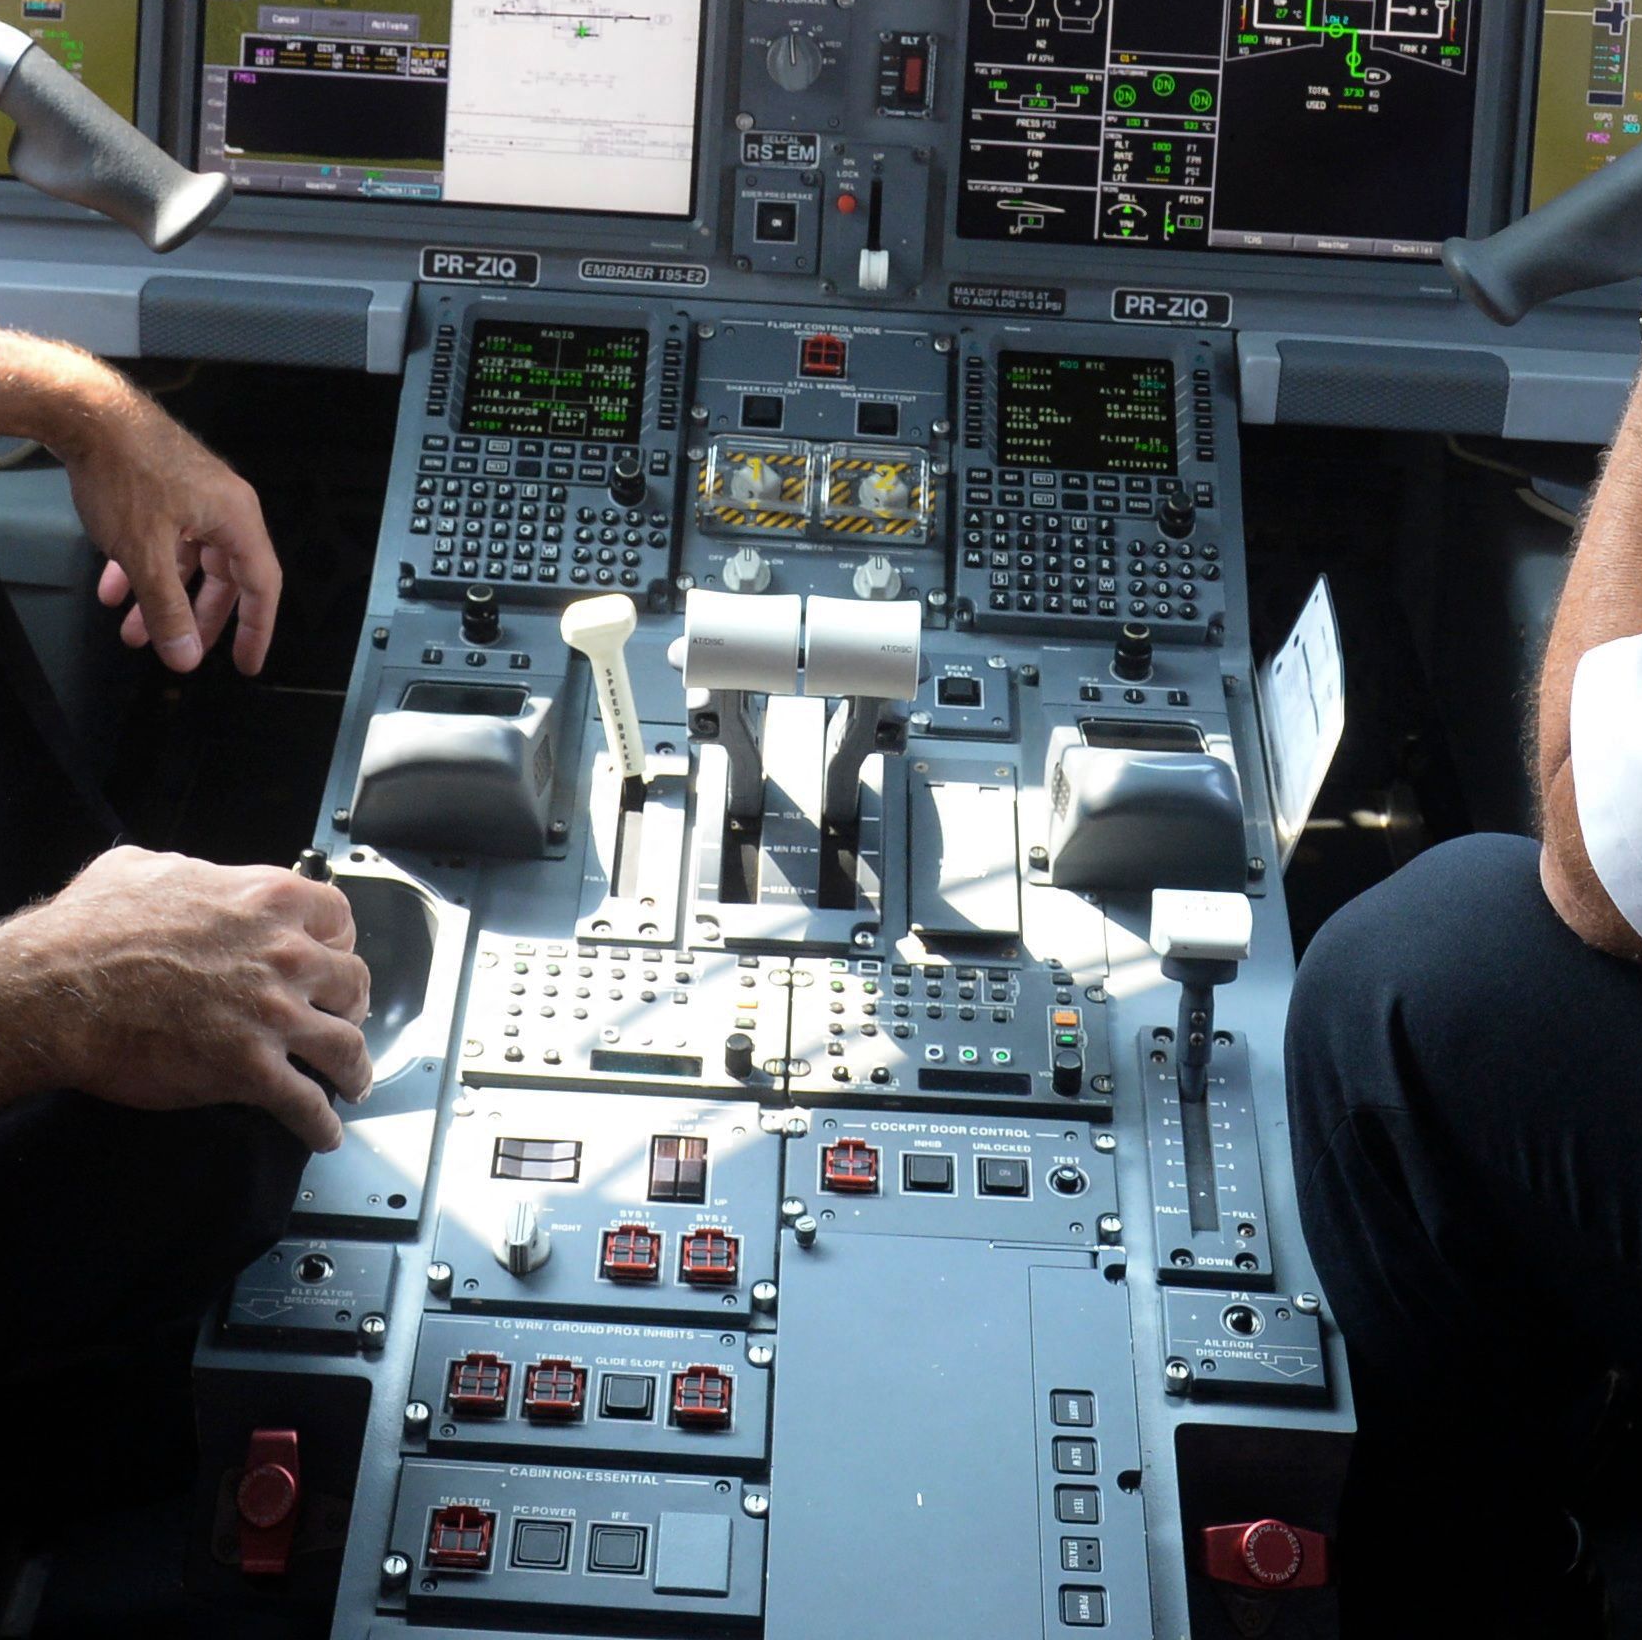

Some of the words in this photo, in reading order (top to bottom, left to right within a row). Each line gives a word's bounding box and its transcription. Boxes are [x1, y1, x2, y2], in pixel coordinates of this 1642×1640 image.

[901, 36, 919, 45] ELT
[1158, 79, 1171, 90] DN
[1117, 90, 1133, 102] DN
[1193, 95, 1208, 106] DN
[763, 136, 800, 144] SELCAL
[747, 144, 814, 160] RS-EM
[433, 254, 516, 278] PR-ZIQ
[583, 263, 654, 280] EMBRAER
[659, 269, 704, 283] 195-E2
[954, 287, 975, 297] MAX
[977, 288, 998, 298] DIFF
[1002, 289, 1033, 300] PRESS
[1035, 291, 1050, 300] AT
[970, 297, 992, 307] AND
[995, 298, 1016, 308] LDG
[1045, 302, 1062, 311] PSI
[1125, 295, 1209, 319] PR-ZIQ
[767, 322, 802, 330] FLIGHT
[806, 323, 851, 333] CONTROL
[541, 330, 575, 340] RADIO
[726, 384, 758, 392] SHAKER
[767, 387, 801, 395] CUTOUT
[787, 381, 813, 389] STALL
[817, 383, 856, 391] WARNING
[840, 391, 873, 399] SHAKER
[882, 394, 917, 402] CUTOUT
[592, 428, 625, 437] IDENT
[875, 465, 896, 492] 2
[692, 637, 724, 646] AT/DISC
[880, 644, 912, 654] AT/DISC
[604, 668, 621, 721] SPEED
[617, 723, 633, 771] BRAKE
[773, 845, 788, 854] MIN
[790, 845, 808, 854] REV
[871, 1122, 928, 1133] COCKPIT
[930, 1124, 967, 1135] DOOR
[970, 1127, 1031, 1138] CONTROL
[914, 1140, 942, 1148] INHIB
[972, 1142, 1031, 1153] UNLOCKED
[1053, 1156, 1080, 1164] TEST
[619, 1210, 643, 1219] SYS
[696, 1214, 719, 1223] SYS
[1155, 1207, 1179, 1215] FULL
[1232, 1211, 1257, 1220] FULL
[551, 1223, 582, 1232] RIGHT
[310, 1242, 327, 1250] PA
[1198, 1257, 1233, 1267] DOWN
[291, 1288, 353, 1297] ELEVATOR
[1232, 1292, 1250, 1302] PA
[284, 1296, 357, 1306] DISCONNECT
[495, 1320, 512, 1329] LG
[515, 1321, 543, 1331] WRN
[553, 1323, 604, 1335] GROUND
[606, 1326, 640, 1337] PROX
[644, 1329, 694, 1340] INHIBITS
[1204, 1339, 1254, 1349] AILERON
[1196, 1348, 1269, 1360] DISCONNECT
[596, 1355, 627, 1366] GLIDE
[630, 1357, 666, 1369] SLOPE
[510, 1466, 550, 1479] CABIN
[553, 1469, 659, 1485] NON-ESSENTIAL
[440, 1495, 490, 1508] MASTER
[1074, 1498, 1084, 1515] TEST
[512, 1505, 529, 1515] PC
[532, 1506, 576, 1518] POWER
[611, 1512, 629, 1521] IFE
[1068, 1541, 1079, 1568] STATUS
[1079, 1595, 1090, 1620] POWER
